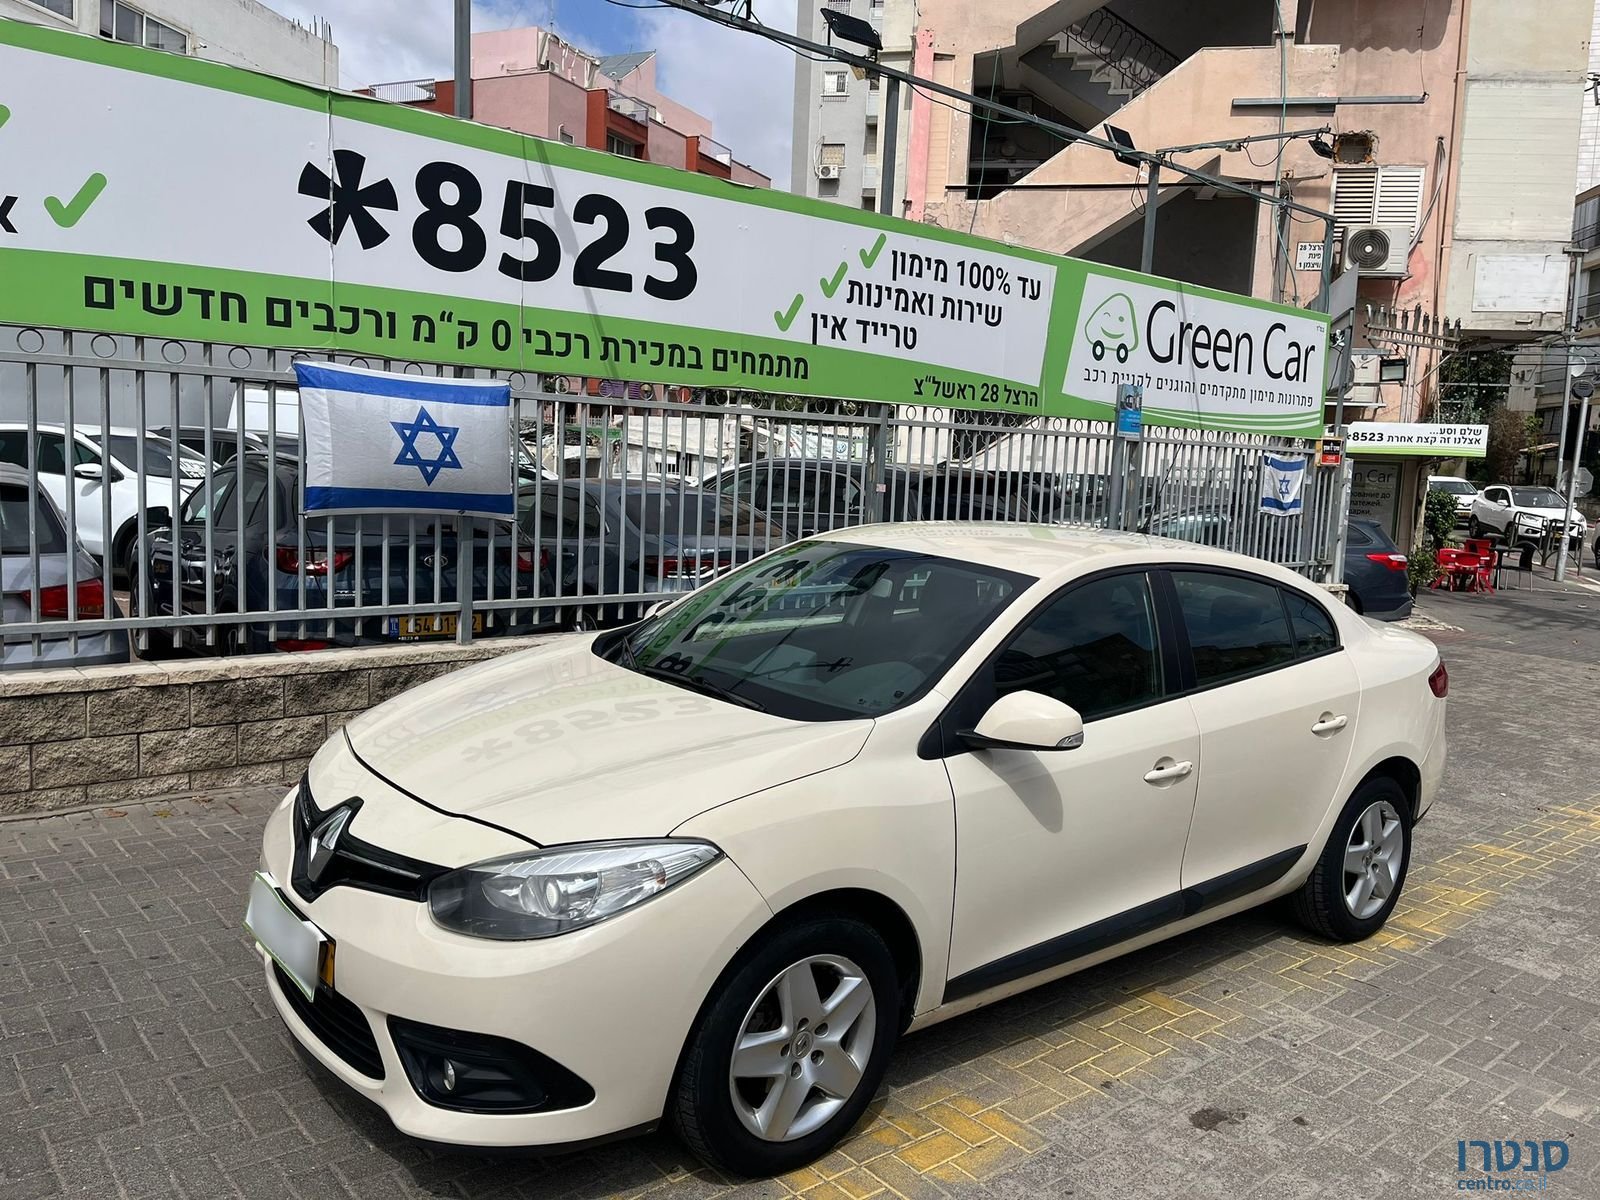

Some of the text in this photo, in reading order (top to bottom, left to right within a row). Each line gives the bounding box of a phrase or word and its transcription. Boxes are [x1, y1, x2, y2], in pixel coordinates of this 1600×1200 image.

[891, 250, 1042, 301] עד 100% מימון
[846, 280, 1003, 328] שירות ואמינות
[84, 275, 809, 380] מתמחים במכירת רכבי 0 ק"מ ורכבים חדשים
[811, 312, 918, 350] טרייד אין
[1146, 300, 1316, 383] Green Car
[914, 375, 1039, 407] הרצל 28 ראשל"צ
[1083, 368, 1313, 407] פתרונות מימון מתקדמים והוגנים לקניית רכב
[1387, 435, 1413, 443] אחרת
[1416, 435, 1437, 445] קצת
[1439, 436, 1451, 444] זה
[1453, 436, 1482, 445] אצלנו
[1460, 427, 1482, 436] שלם
[1367, 469, 1392, 482] Car
